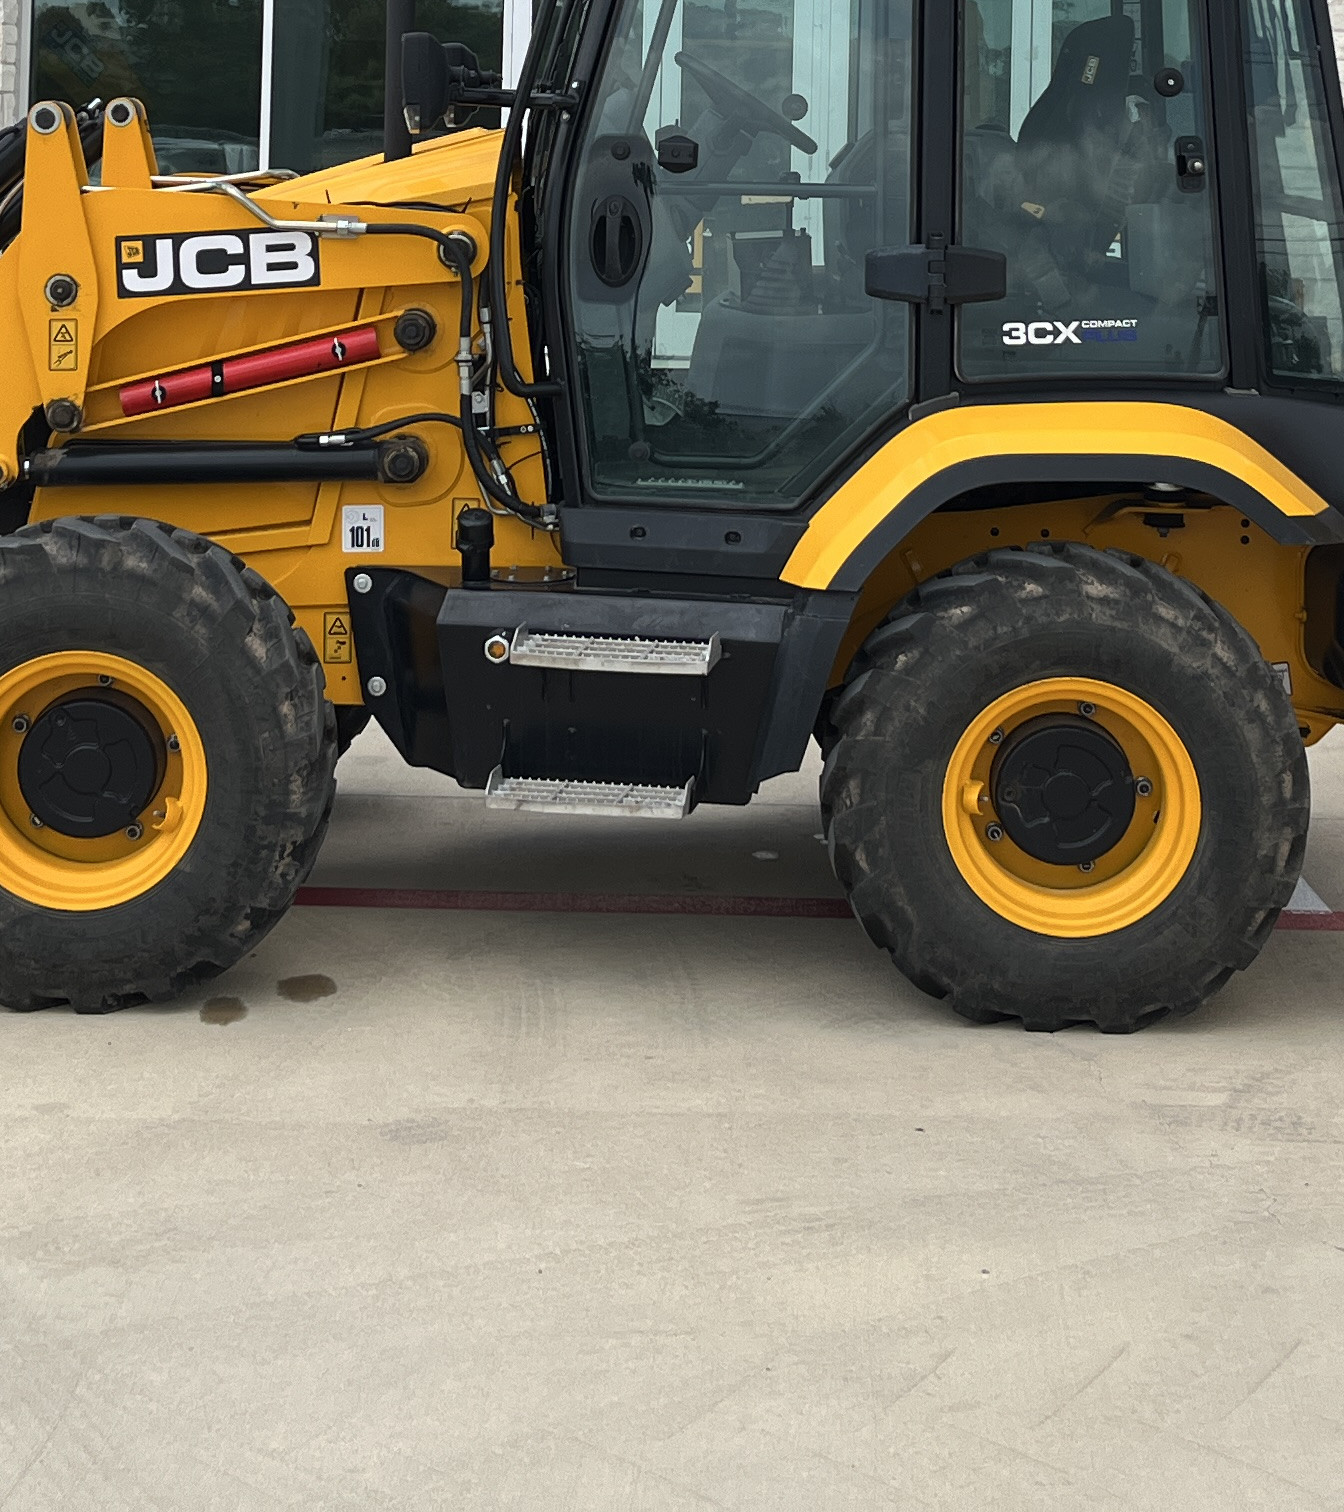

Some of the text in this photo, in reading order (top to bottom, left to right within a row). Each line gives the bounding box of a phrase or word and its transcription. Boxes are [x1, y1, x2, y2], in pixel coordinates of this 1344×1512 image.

[122, 231, 315, 293] JCB
[1002, 321, 1083, 346] 3CX
[1081, 319, 1138, 328] COMPACT
[349, 525, 371, 548] 101
